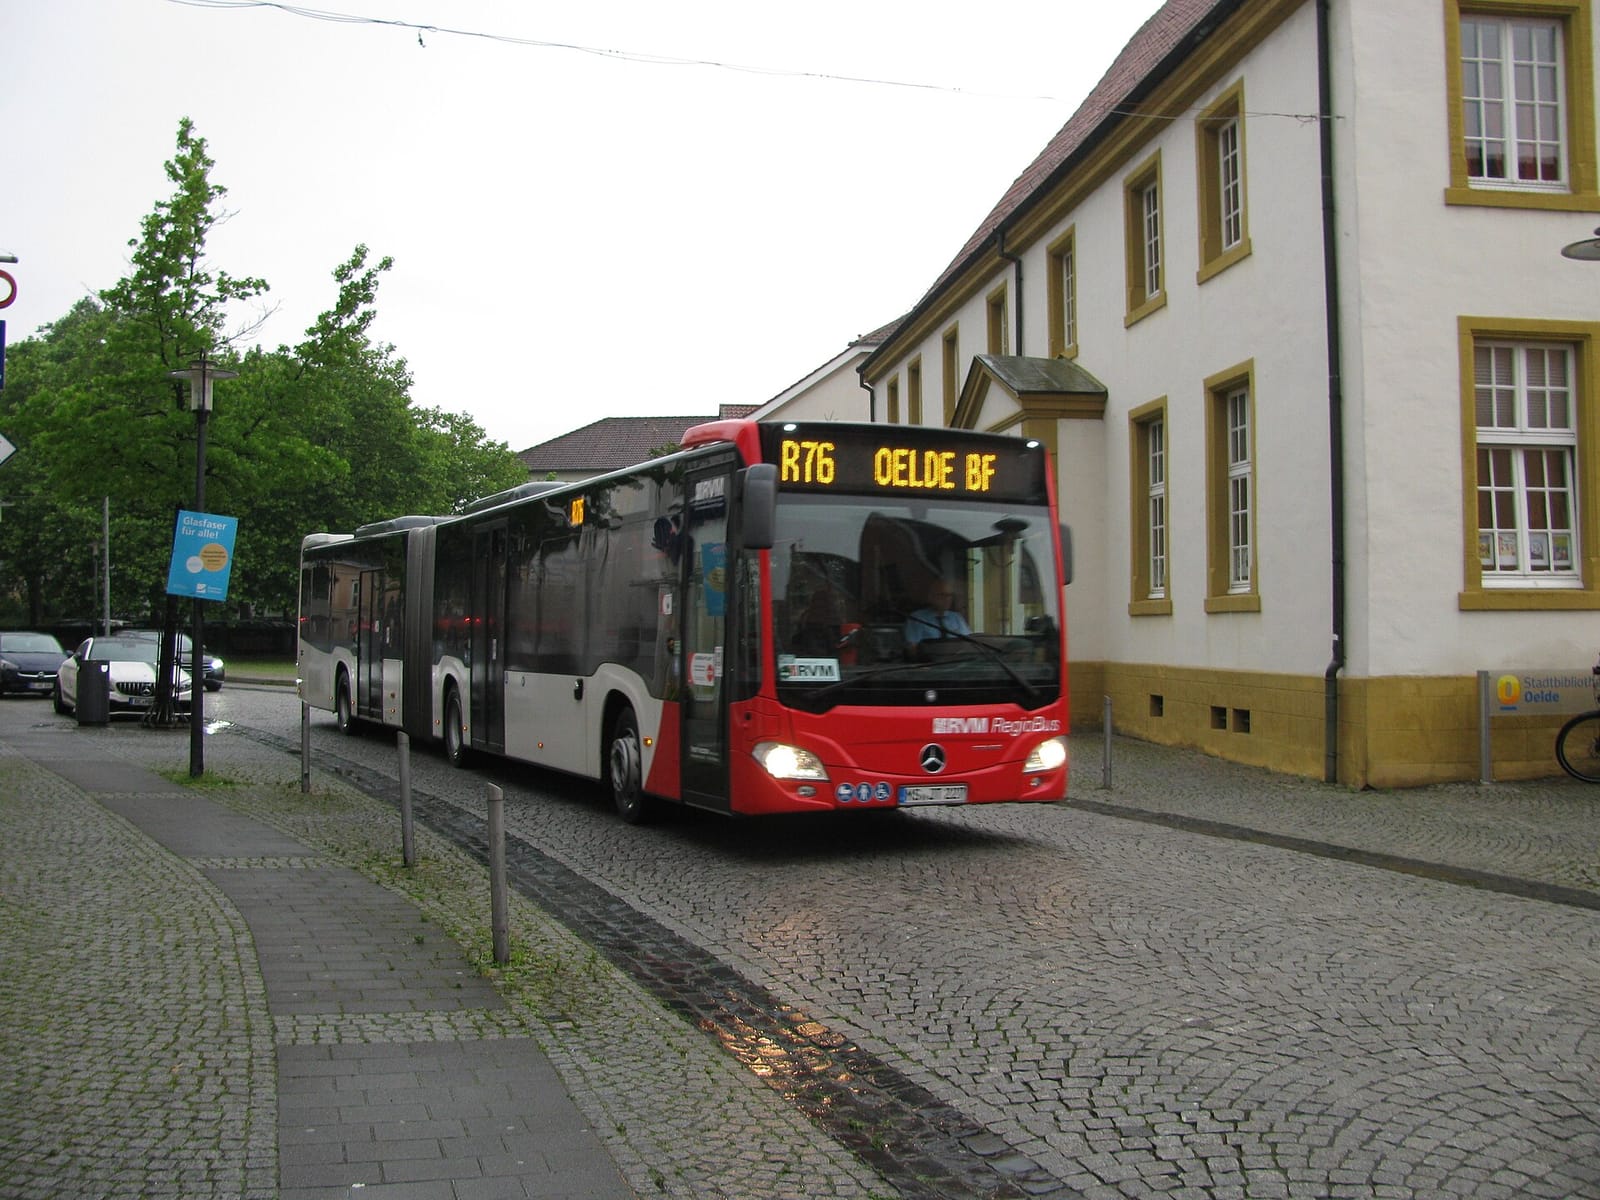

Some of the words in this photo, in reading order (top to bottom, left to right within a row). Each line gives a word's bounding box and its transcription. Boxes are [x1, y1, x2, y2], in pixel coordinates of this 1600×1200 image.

[781, 440, 835, 484] R76
[874, 447, 955, 489] OELDE
[965, 453, 996, 491] BF
[183, 516, 227, 530] Glasfaser
[181, 526, 195, 536] für
[198, 529, 219, 539] alle!
[799, 665, 834, 677] RVM
[1524, 691, 1559, 703] Oelde
[946, 717, 989, 734] RVM
[990, 716, 1060, 736] RegioBus
